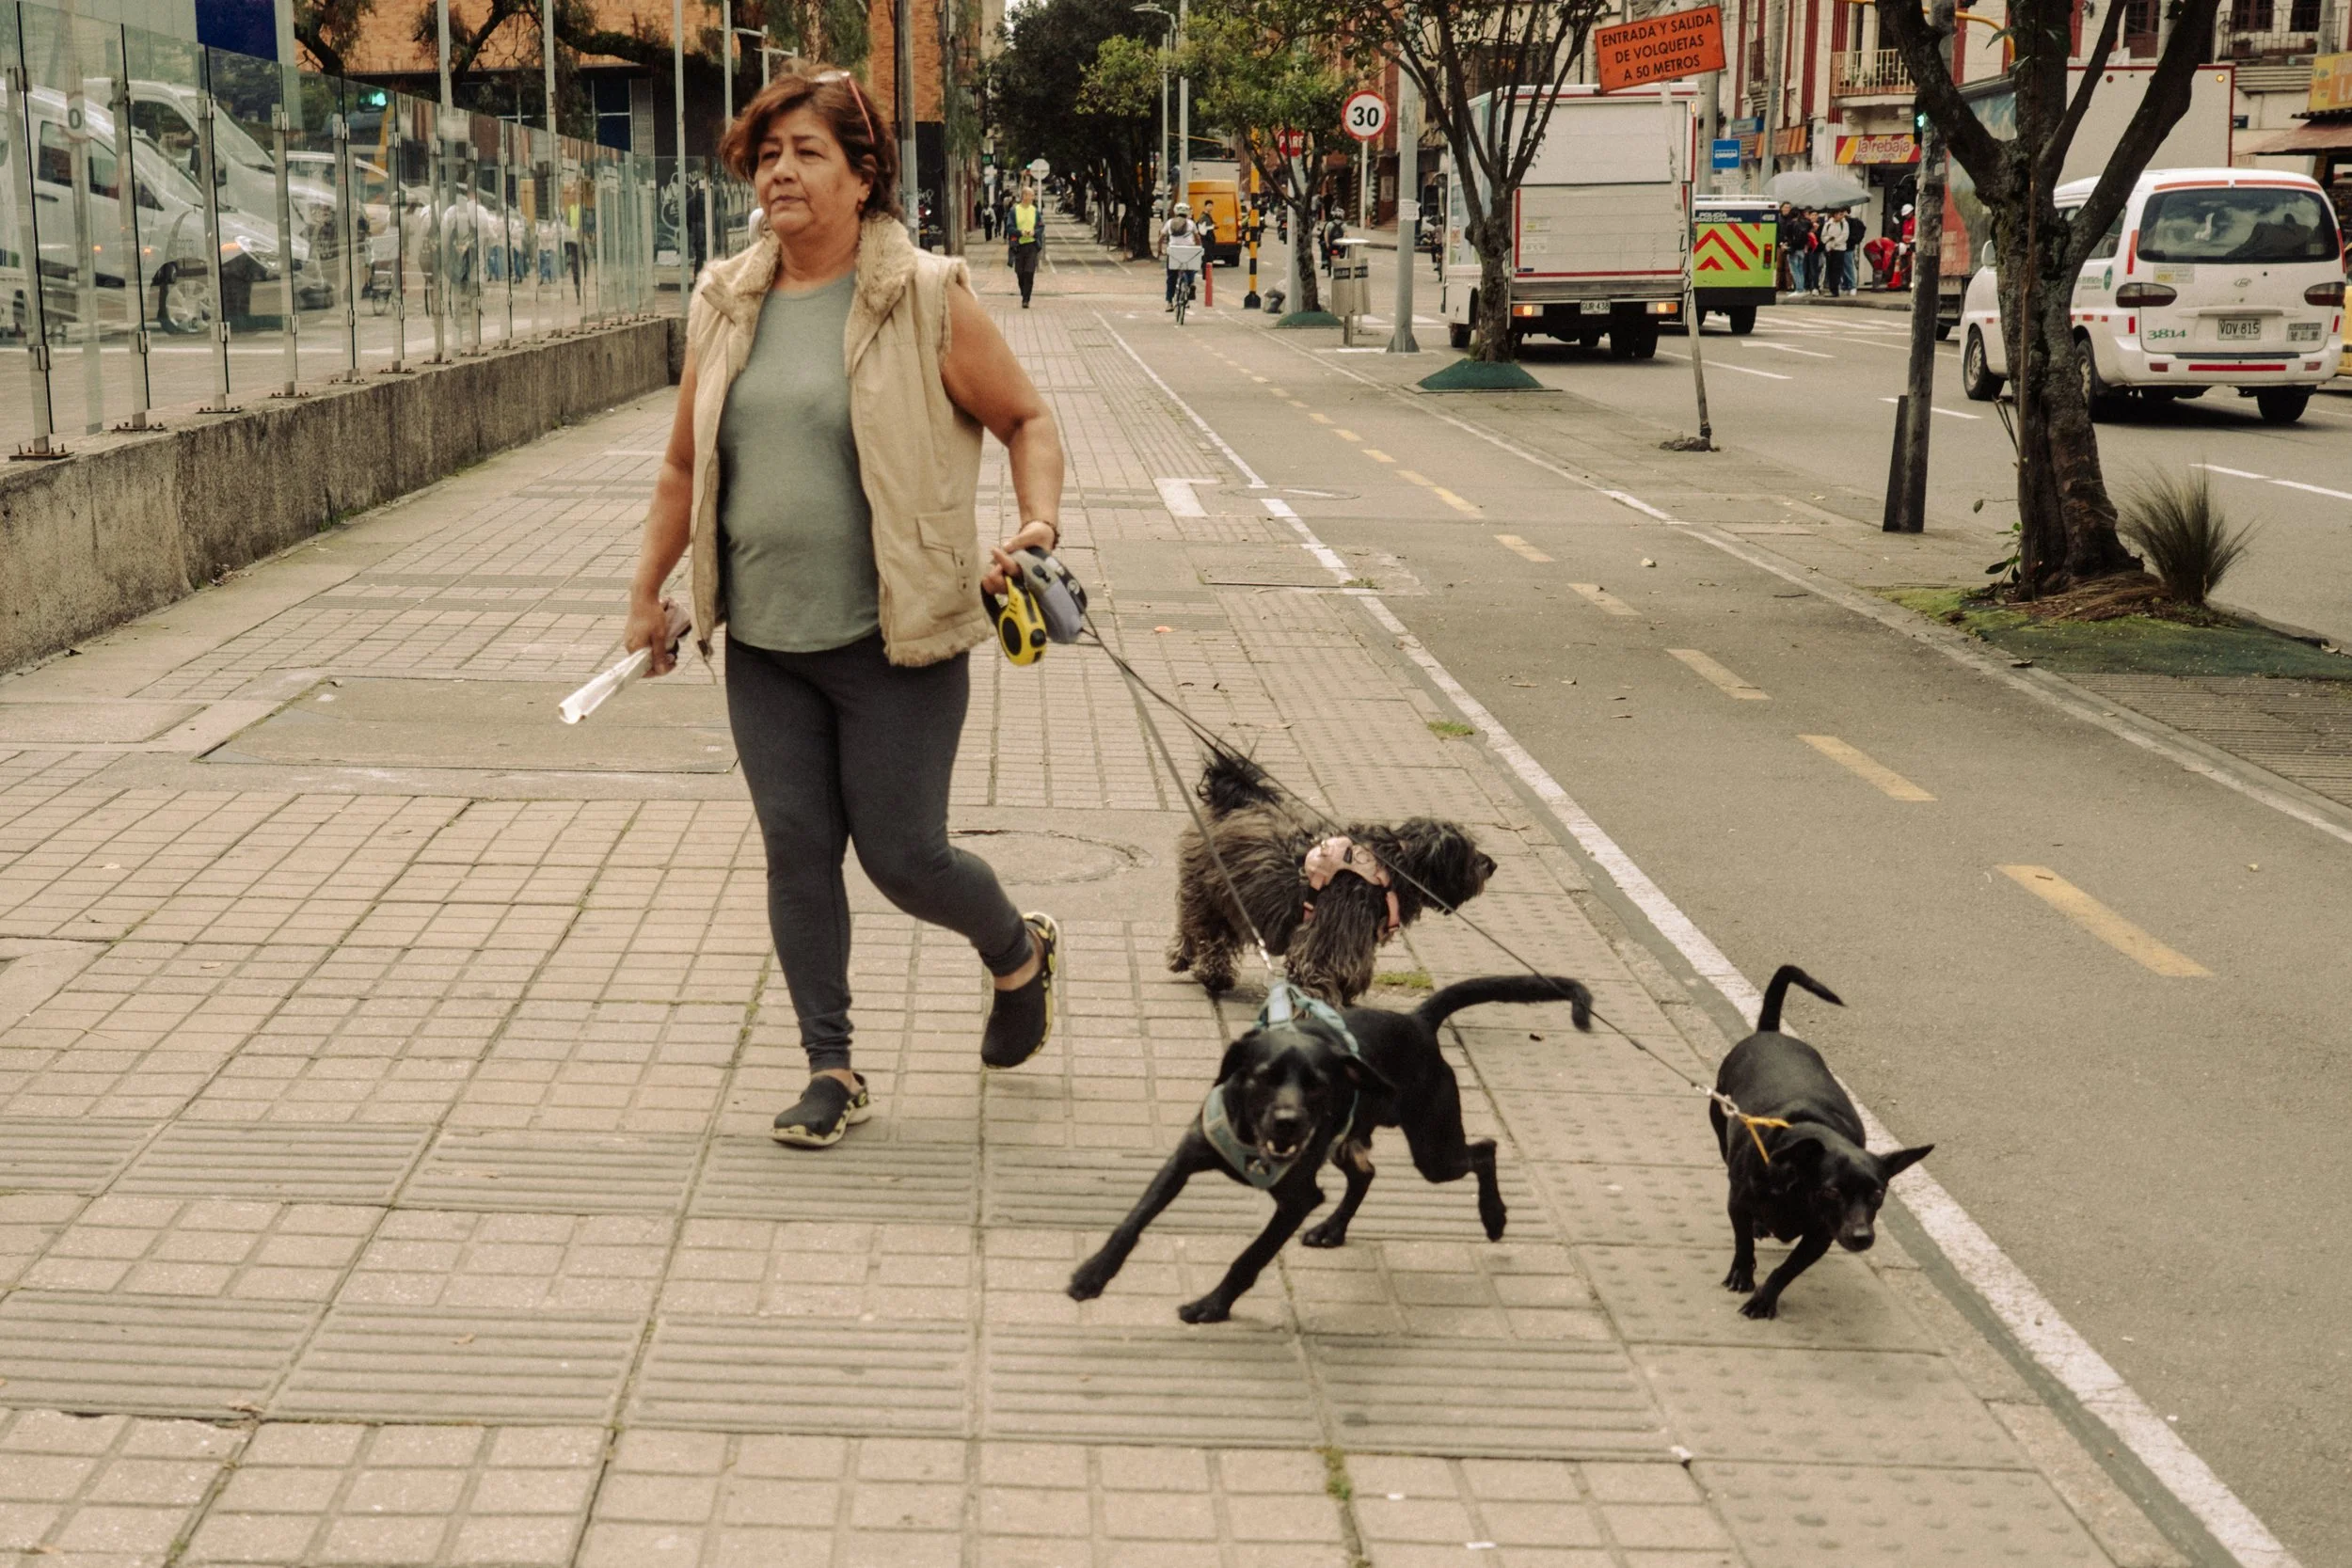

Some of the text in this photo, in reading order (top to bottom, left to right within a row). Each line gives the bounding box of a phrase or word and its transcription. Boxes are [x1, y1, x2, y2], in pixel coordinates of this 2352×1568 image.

[1602, 13, 1713, 47] ENTRADA Y SALIDA
[1615, 34, 1705, 64] DE VOLQUETAS
[1624, 55, 1700, 81] A 50 METROS
[1353, 106, 1379, 127] 30
[1279, 135, 1304, 148] PRE
[2147, 329, 2186, 340] 3814
